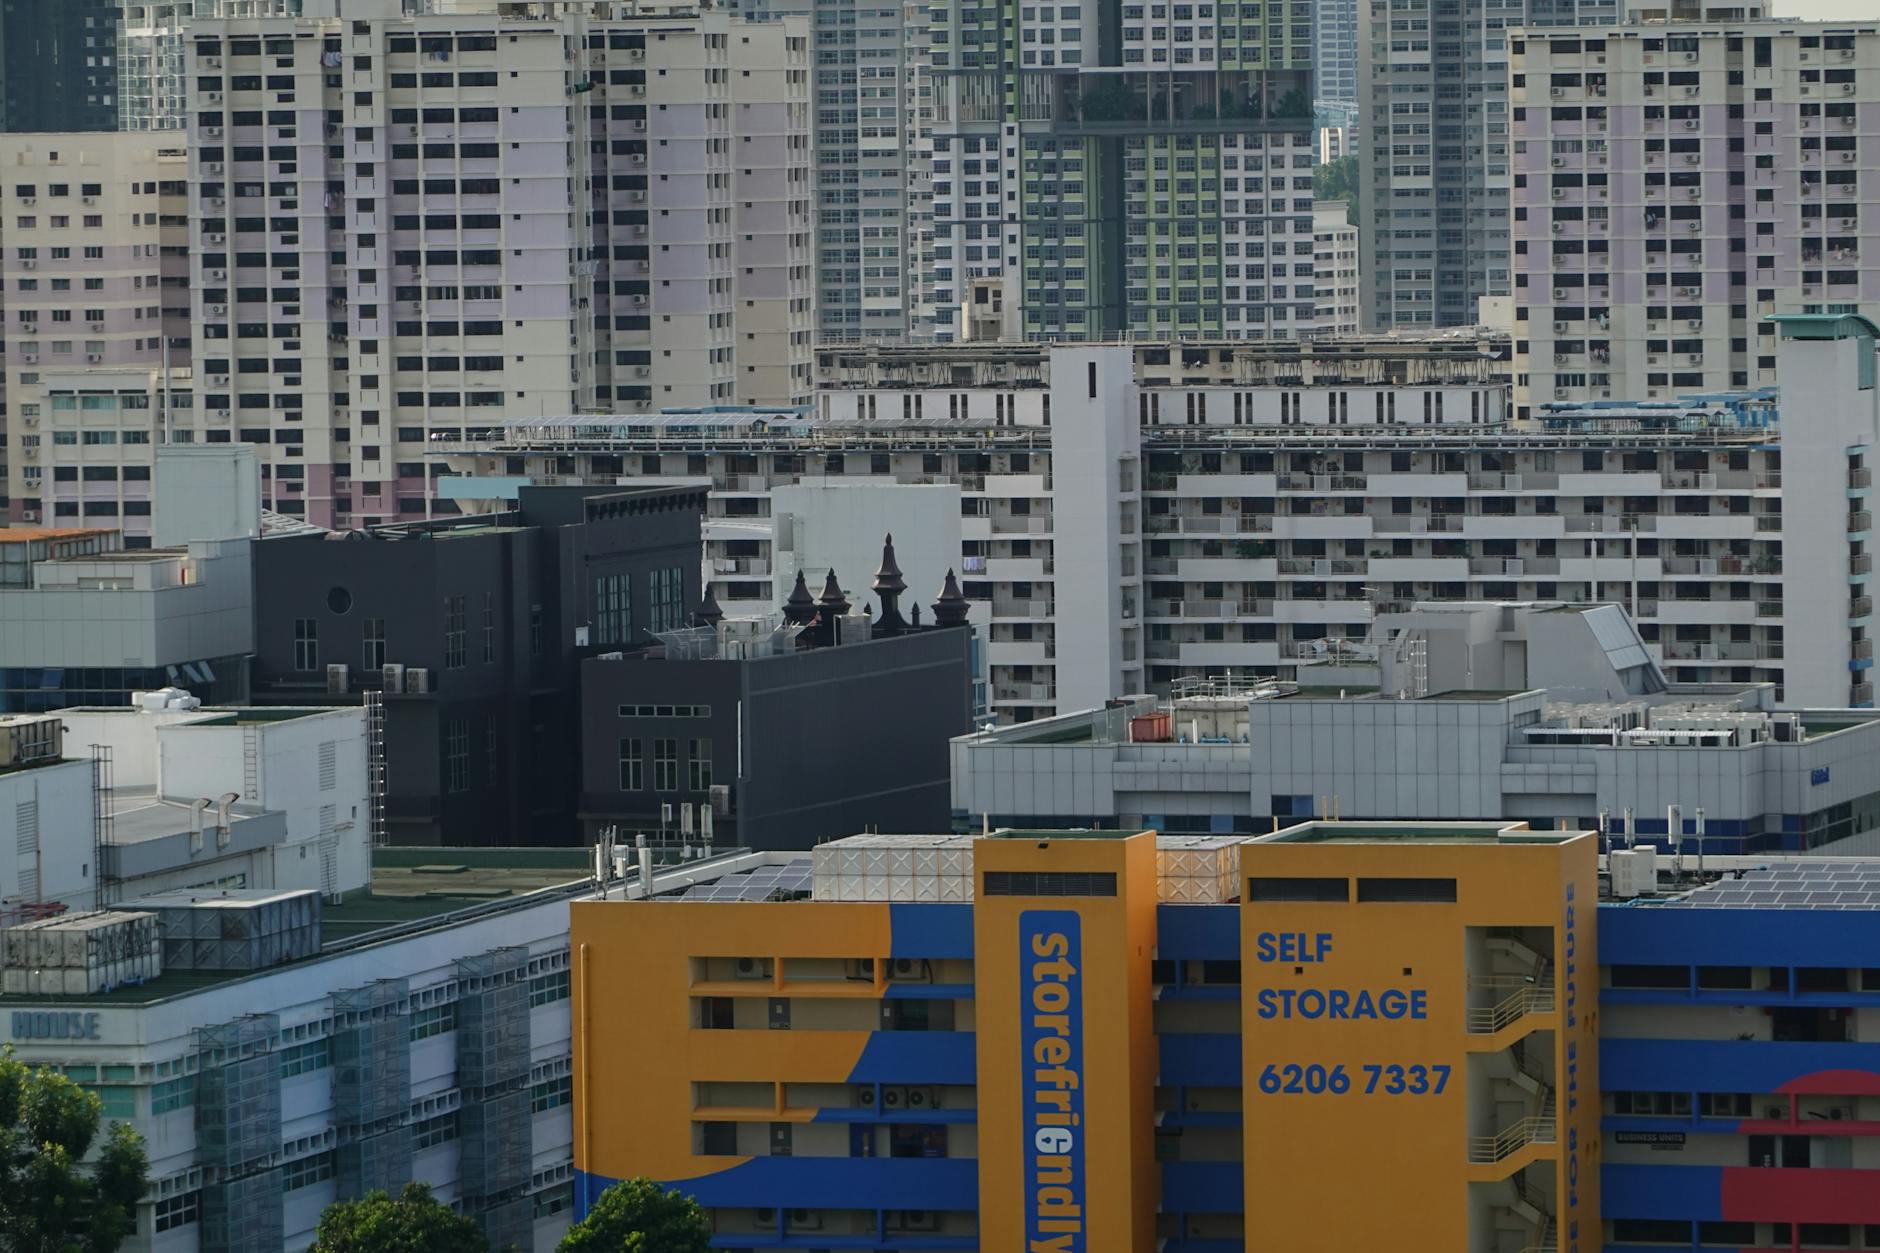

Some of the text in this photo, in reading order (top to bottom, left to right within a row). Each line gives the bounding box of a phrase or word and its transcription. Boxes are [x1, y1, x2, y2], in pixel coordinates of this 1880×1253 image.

[1257, 931, 1332, 963] SELF
[1566, 882, 1576, 1028] FUTURE
[1257, 988, 1428, 1020] STORAGE
[12, 1011, 100, 1039] HOUSE
[1259, 1063, 1452, 1095] 6206 7337
[1567, 1040, 1577, 1116] THE
[1567, 1127, 1578, 1209] FOR
